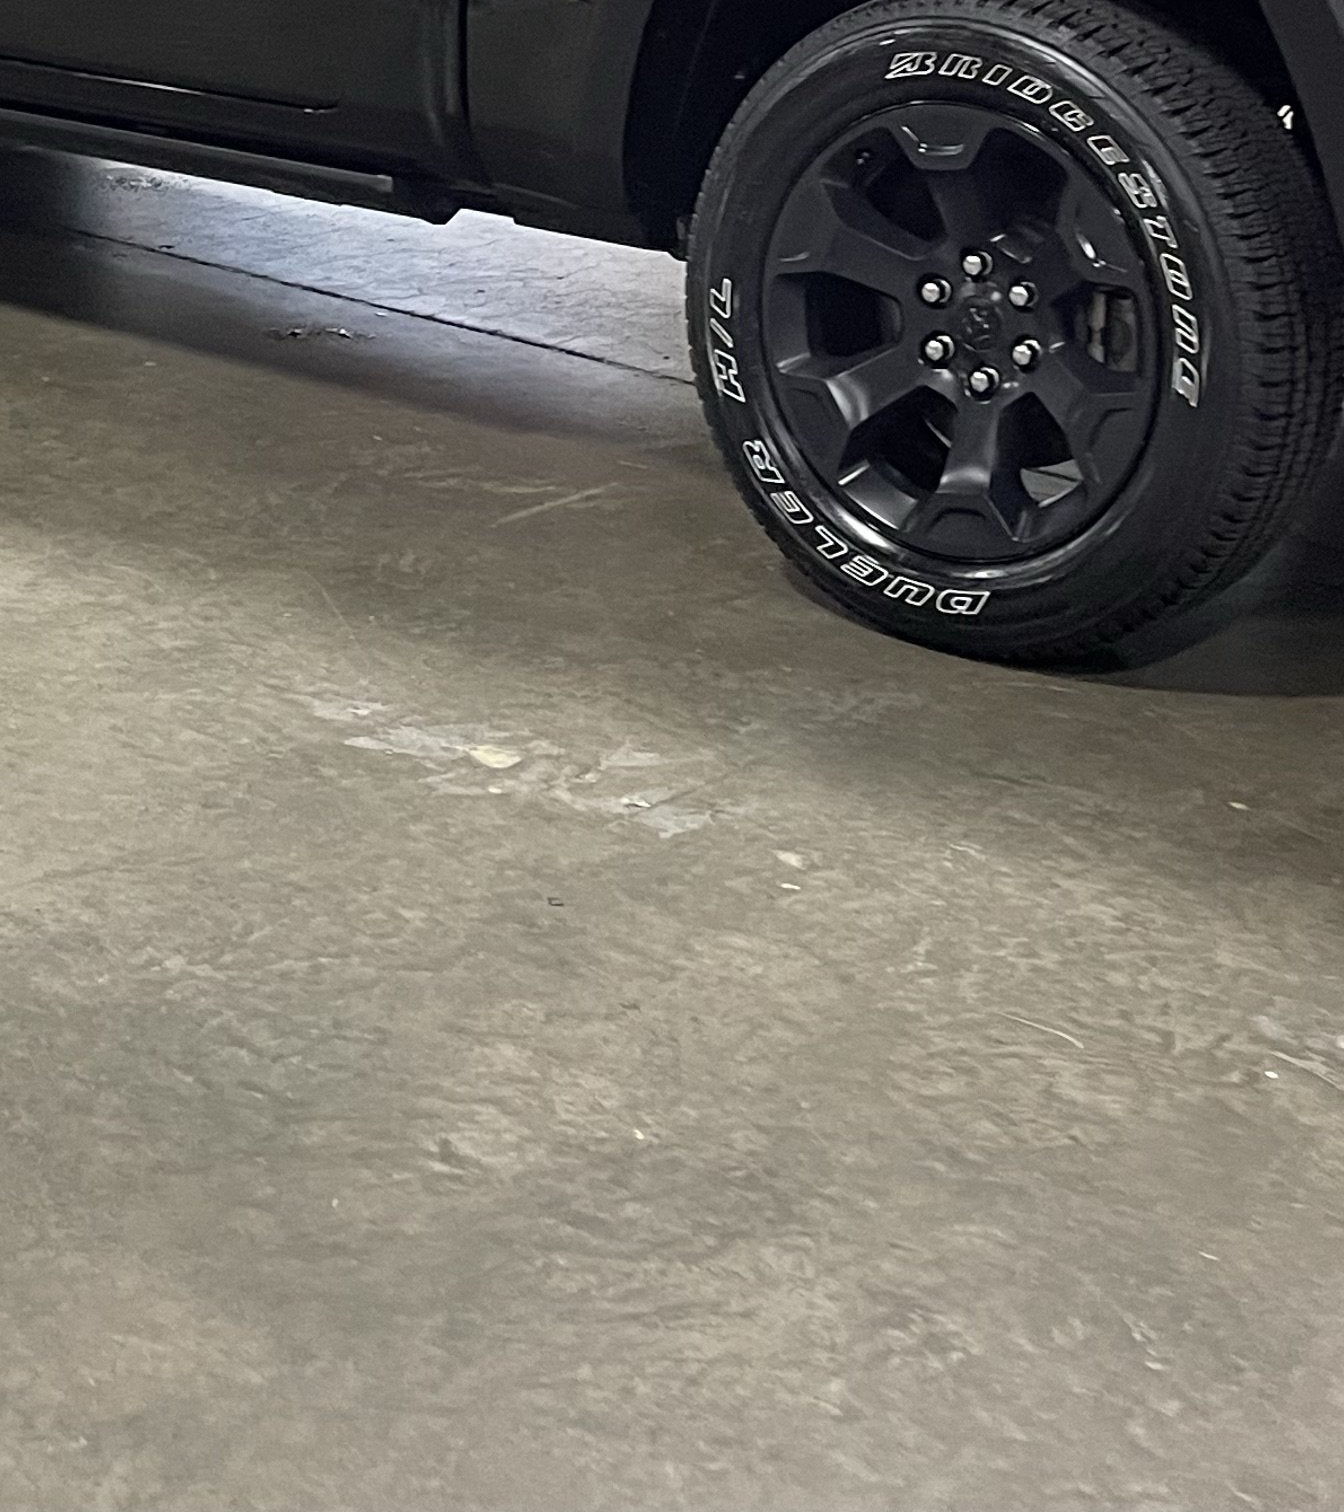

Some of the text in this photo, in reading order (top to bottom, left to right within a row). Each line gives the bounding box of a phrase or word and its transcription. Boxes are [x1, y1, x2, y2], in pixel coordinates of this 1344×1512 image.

[885, 51, 1200, 408] BRIDGESTONE
[710, 279, 746, 402] H/L
[742, 439, 990, 616] DUELER
